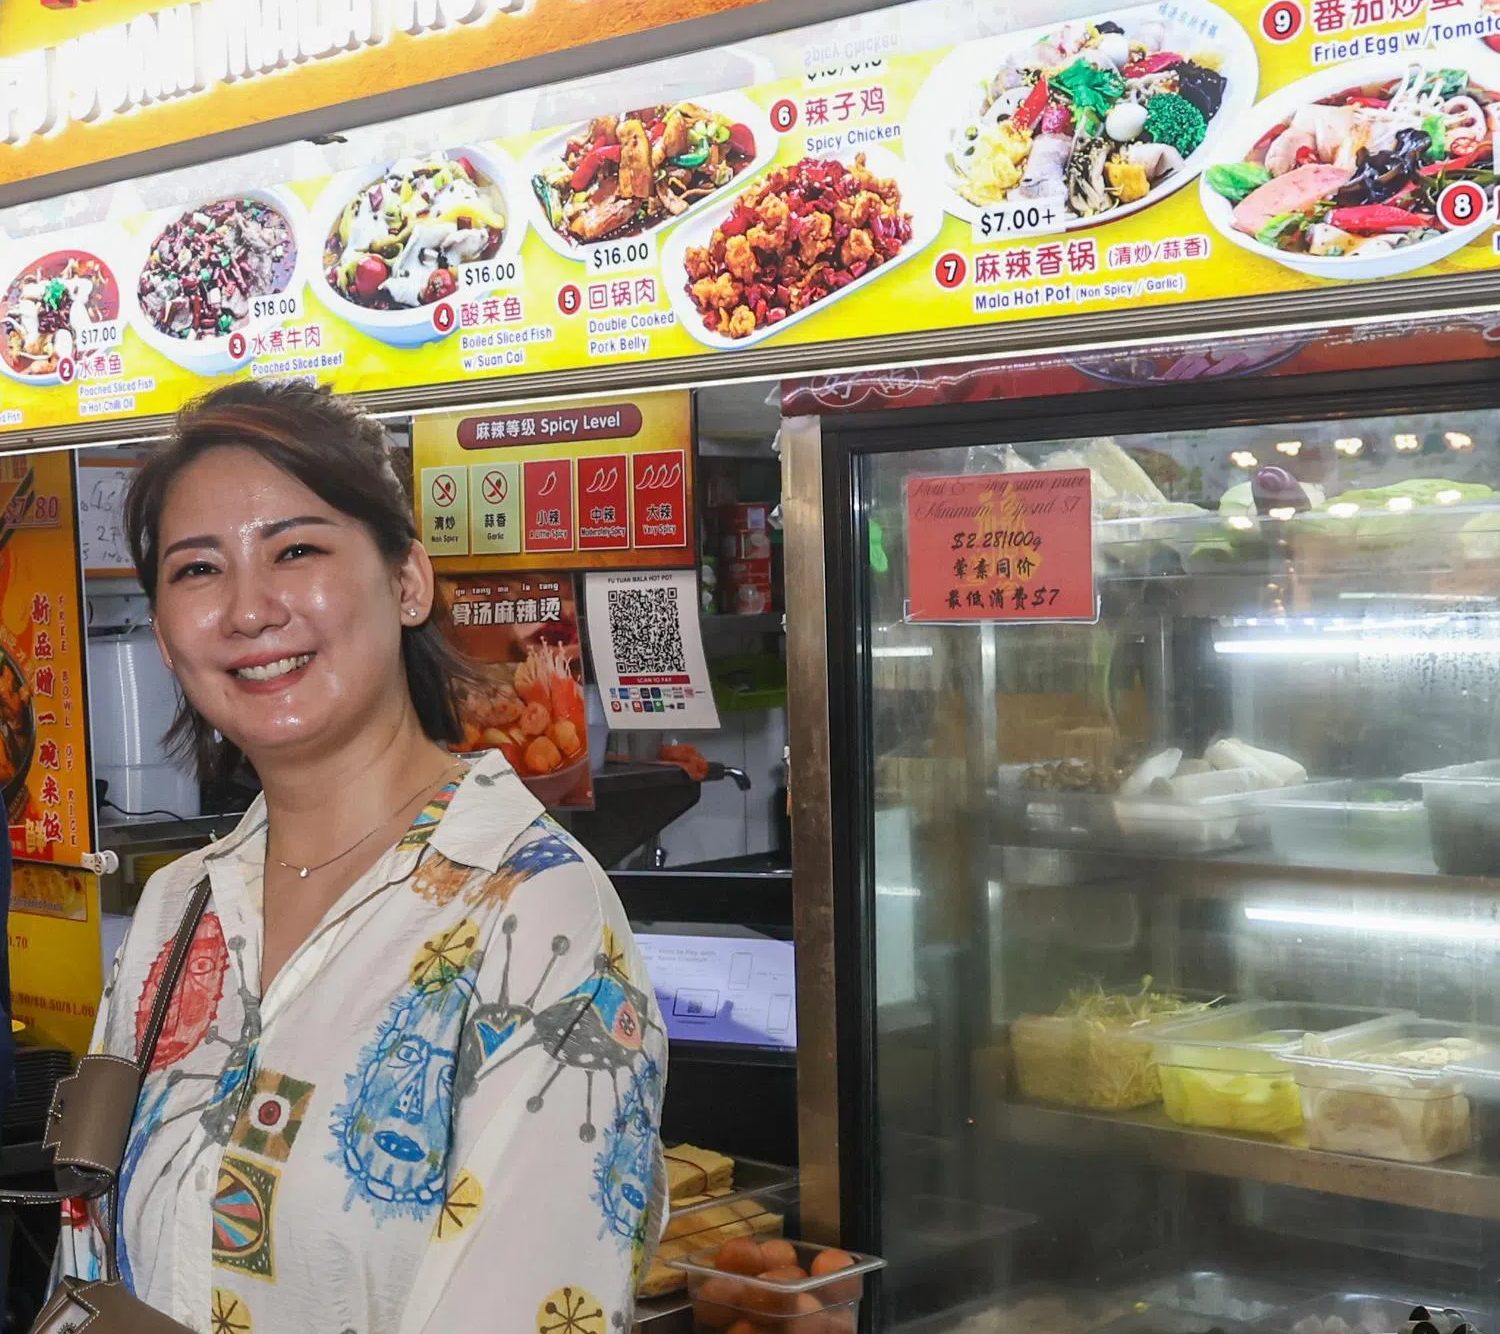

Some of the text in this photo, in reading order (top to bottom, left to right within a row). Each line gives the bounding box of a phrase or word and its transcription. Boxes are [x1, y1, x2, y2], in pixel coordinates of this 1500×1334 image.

[1270, 7, 1294, 38] 9
[1313, 36, 1360, 63] Fried
[1364, 30, 1401, 58] Egg
[805, 86, 886, 127] 辣子鸡
[806, 124, 901, 154] Spicy Chicken
[980, 206, 1057, 237] $7.00+
[593, 242, 650, 270] $16.00
[974, 240, 1096, 285] 麻辣香锅
[465, 262, 515, 287] $16.00
[254, 298, 297, 318] $18.00
[588, 277, 656, 311] 回锅肉
[975, 294, 1010, 311] Mala
[1014, 289, 1041, 305] Hot
[1045, 285, 1071, 302] Pot
[1104, 281, 1133, 297] Spicy
[461, 296, 523, 328] 酸菜鱼
[589, 312, 675, 334] Double Cooked
[81, 326, 118, 346] $17.00
[252, 325, 321, 356] 水煮牛肉
[462, 327, 553, 349] Boiled Sliced Fish
[590, 336, 648, 355] Pork Belly
[79, 354, 123, 380] 水煮鱼
[292, 357, 319, 371] Sliced
[321, 353, 343, 368] Beef
[506, 350, 524, 365] Cai
[138, 378, 154, 391] Fish
[475, 410, 621, 441] 麻辣等级 Spicy Level
[3, 495, 60, 524] $7.80
[535, 509, 561, 526] 小辣
[591, 506, 616, 524] 中辣
[646, 503, 673, 521] 大辣
[451, 596, 562, 626] 骨汤麻辣烫
